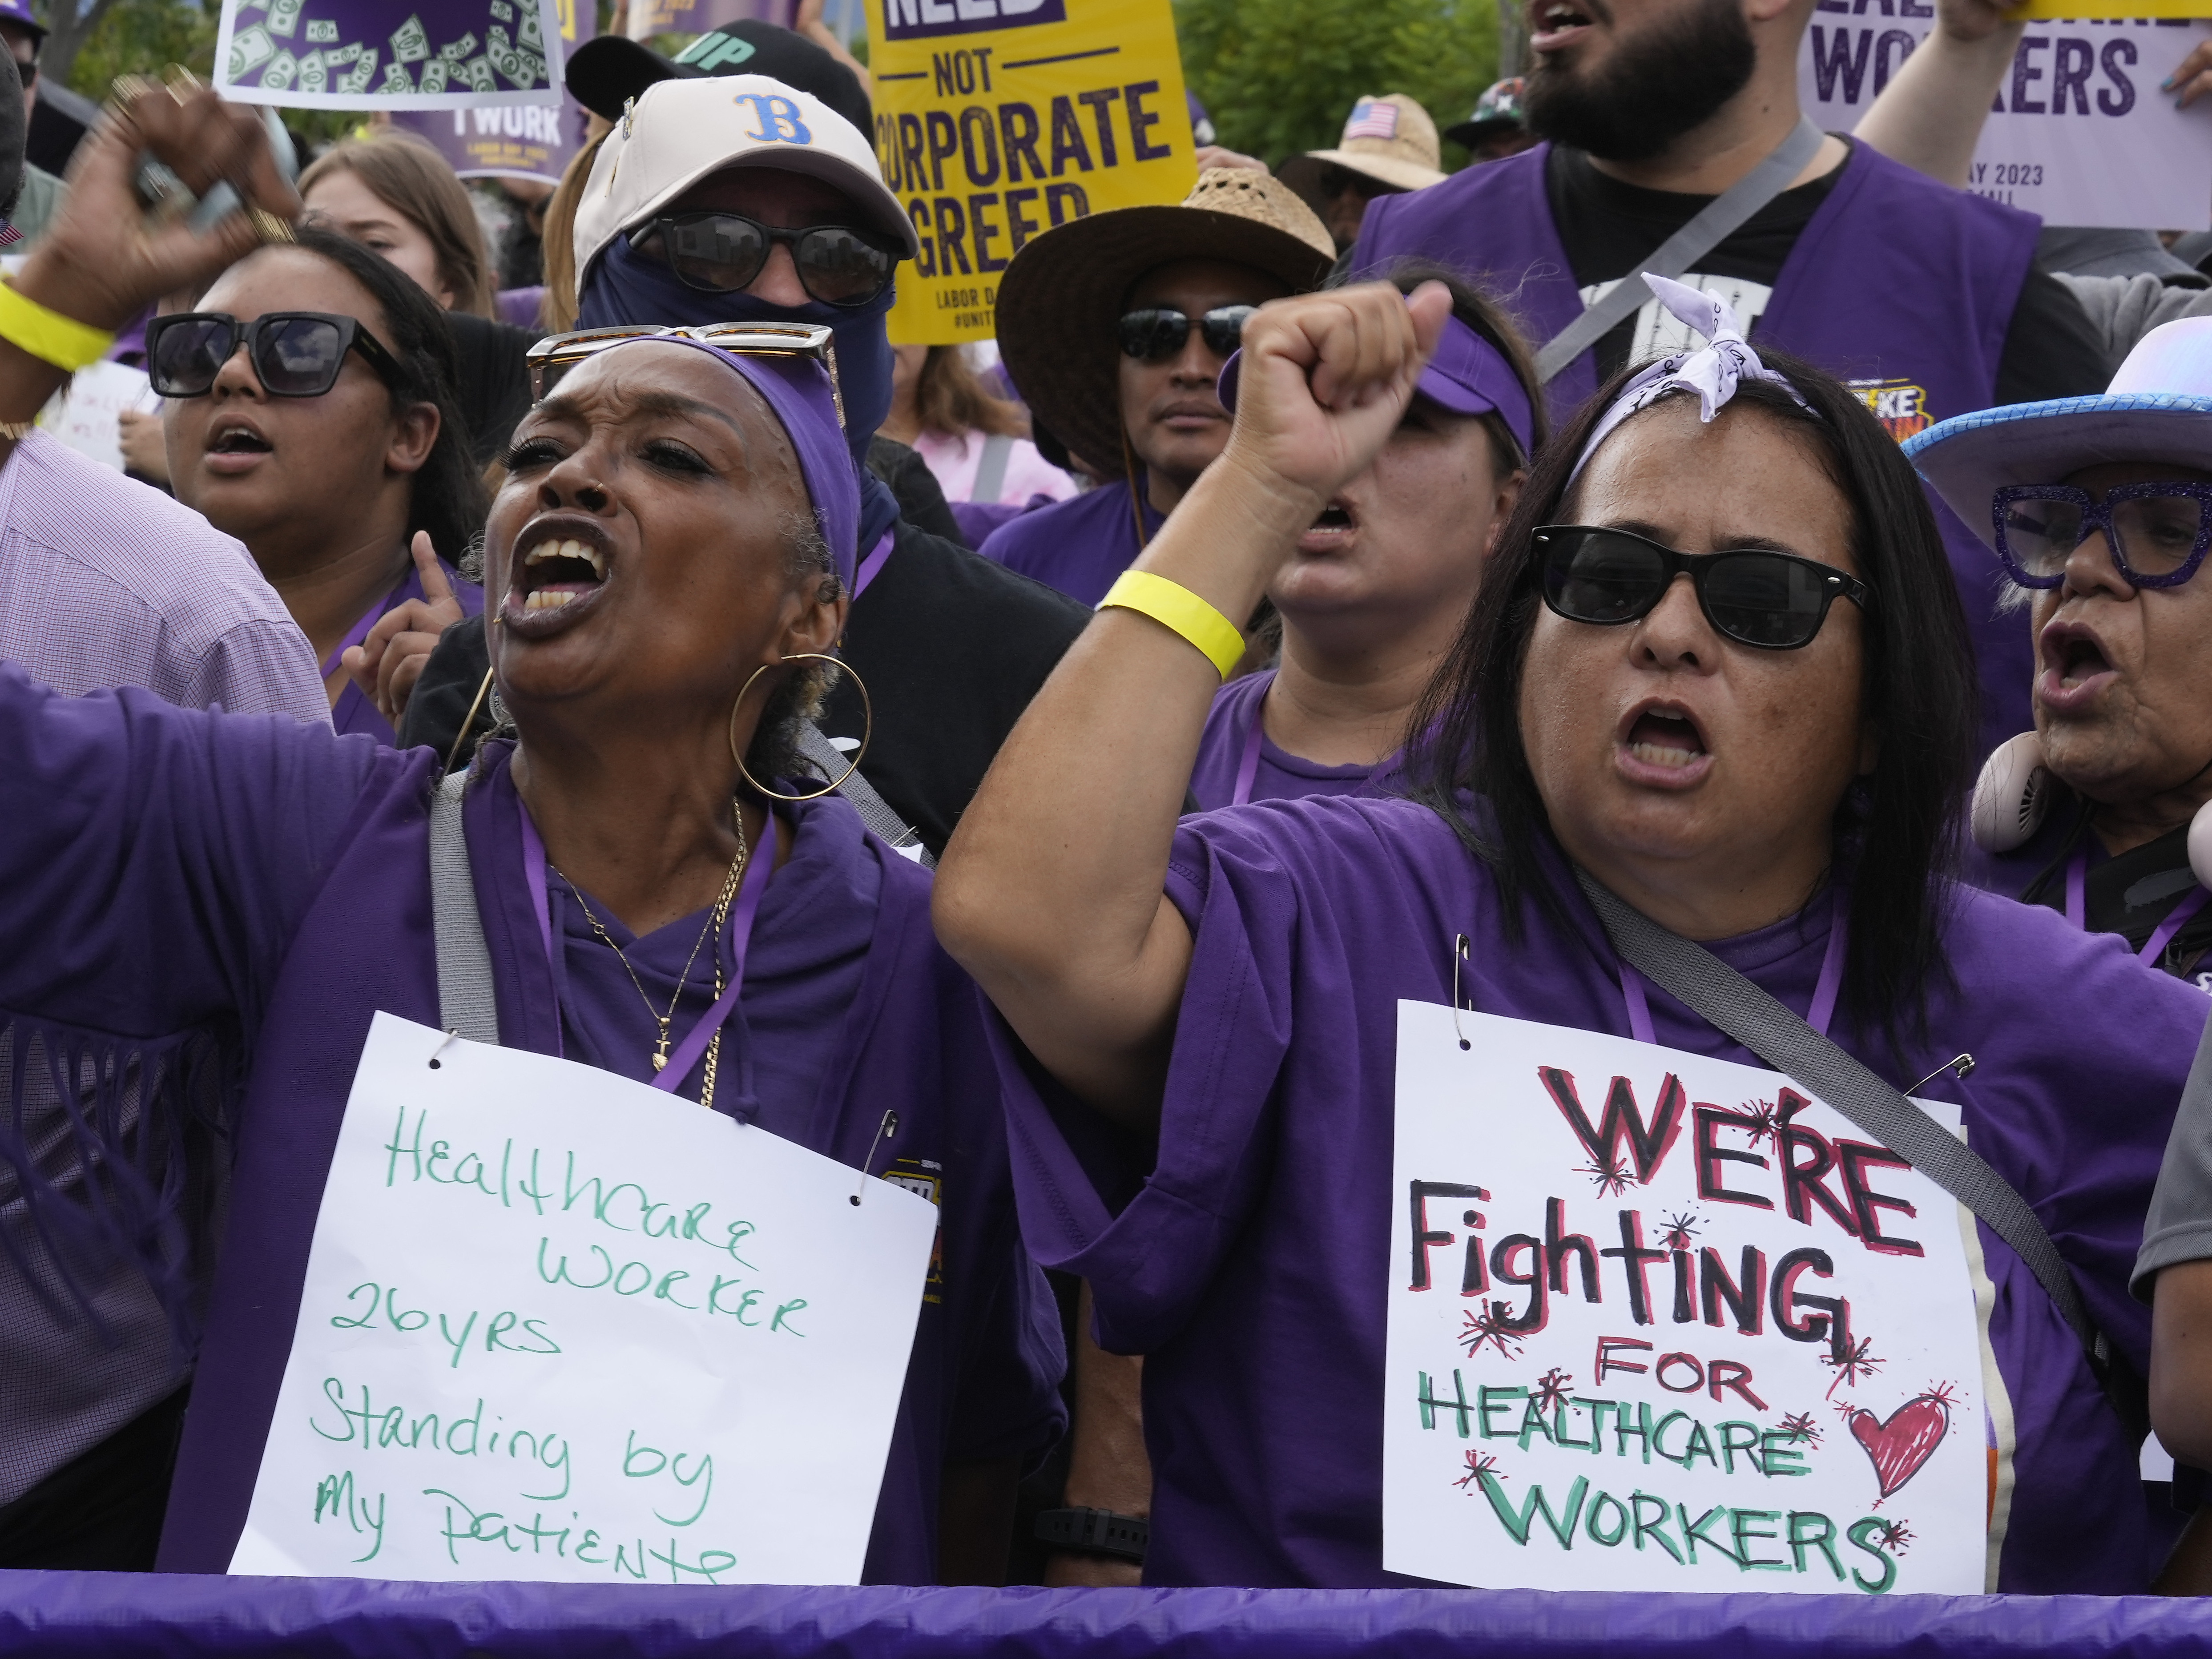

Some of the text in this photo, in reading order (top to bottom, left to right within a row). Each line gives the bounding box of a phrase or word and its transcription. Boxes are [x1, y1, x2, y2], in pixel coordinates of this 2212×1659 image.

[675, 32, 756, 71] UP
[933, 48, 992, 97] NOT
[1811, 25, 2138, 117] WOERS
[734, 93, 812, 145] B
[875, 80, 1171, 193] CORPORATE
[1996, 163, 2043, 185] 2023
[936, 289, 979, 309] LABOR
[1595, 1337, 1769, 1411] FOR
[310, 1377, 712, 1526] Standing by
[1418, 1368, 1812, 1477] HEALTHCARE
[1475, 1467, 1897, 1594] WORKERS
